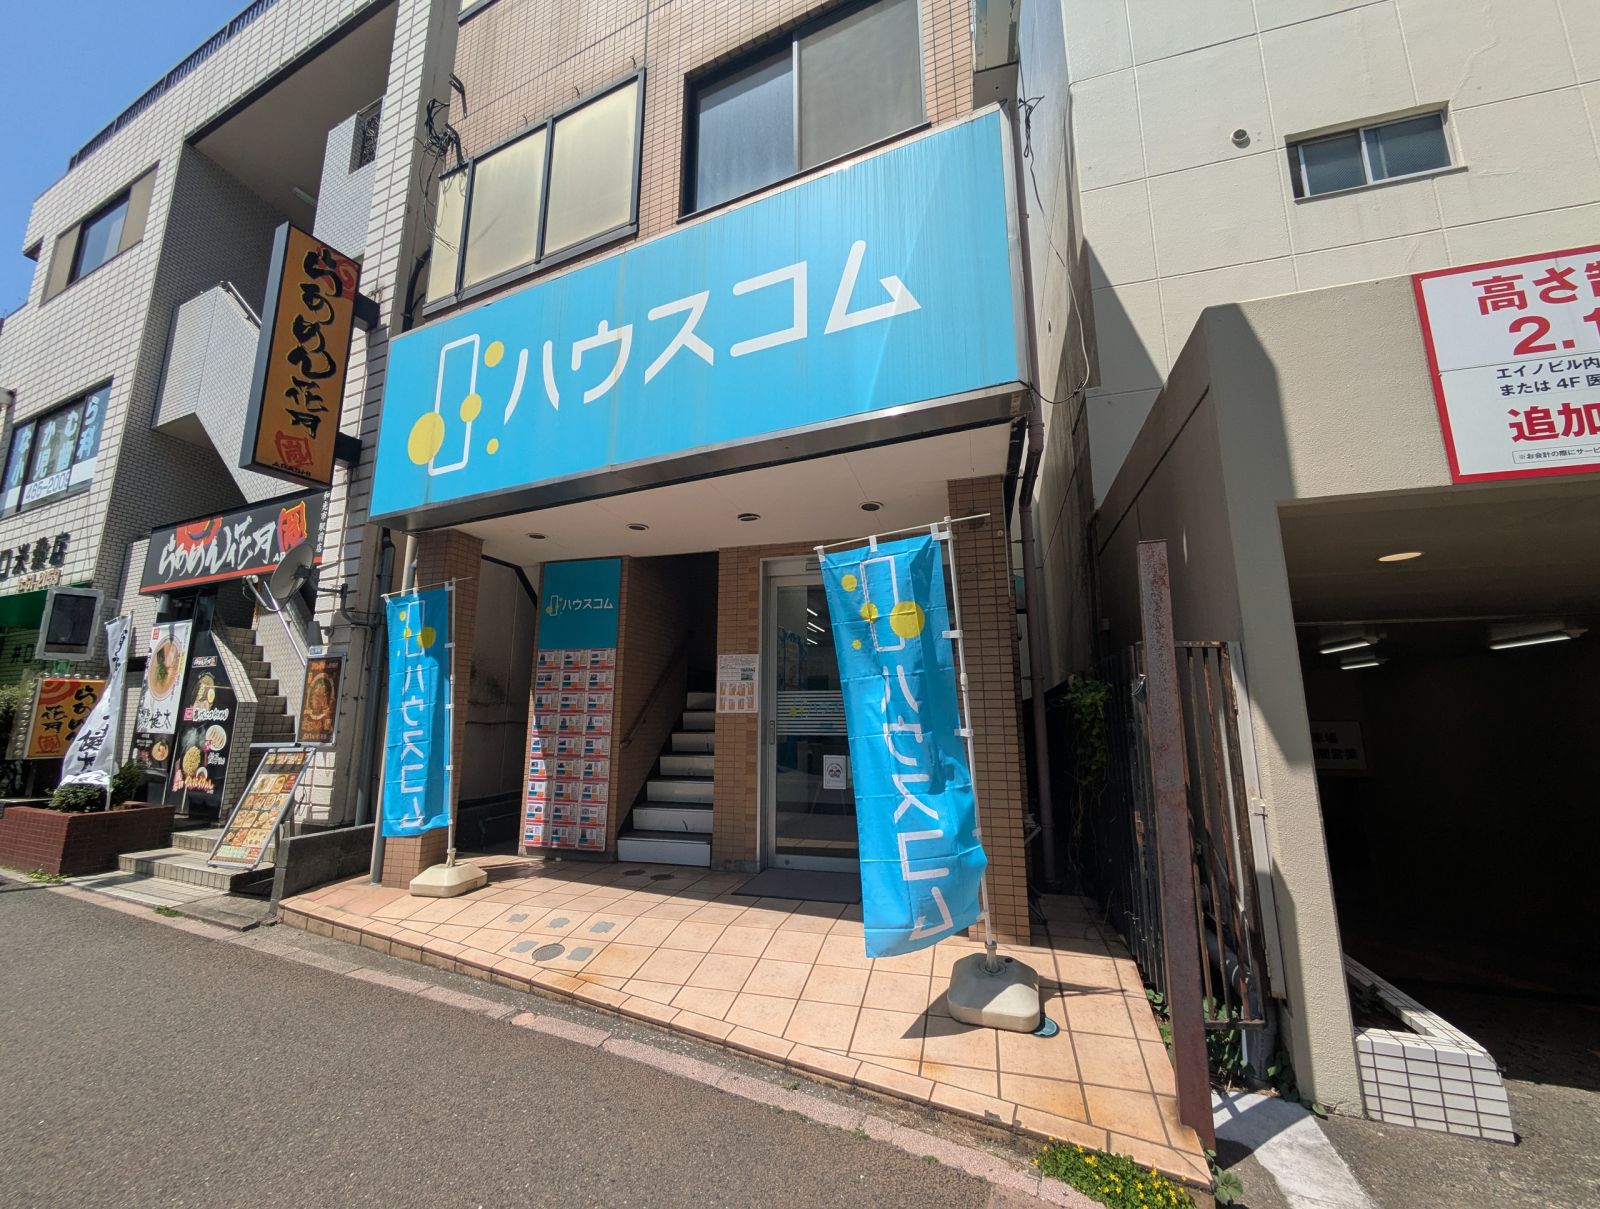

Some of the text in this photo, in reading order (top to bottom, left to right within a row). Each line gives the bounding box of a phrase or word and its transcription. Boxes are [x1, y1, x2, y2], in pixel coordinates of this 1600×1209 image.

[504, 240, 922, 425] ハウスコム
[1497, 357, 1600, 379] エイノビル内
[1500, 380, 1551, 396] または
[1507, 403, 1600, 442] 追加
[562, 598, 613, 611] ハウスコム
